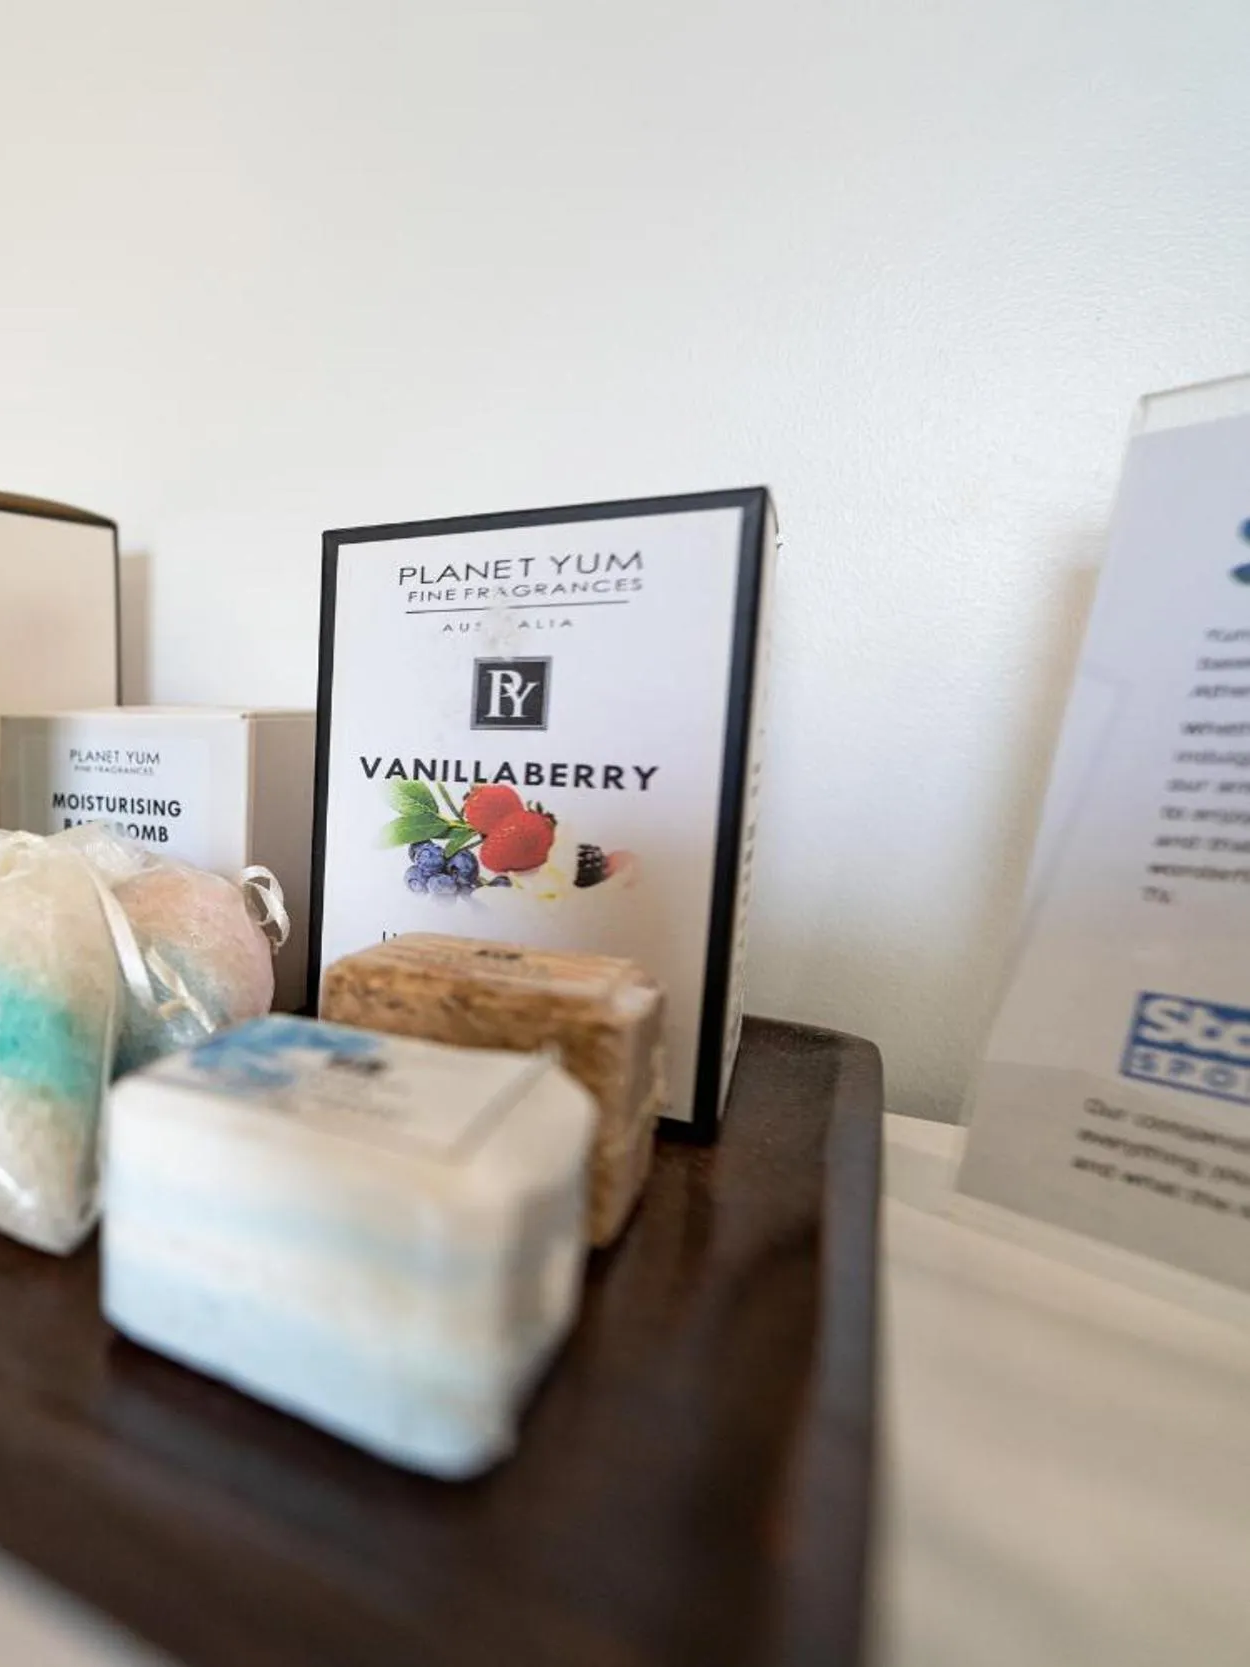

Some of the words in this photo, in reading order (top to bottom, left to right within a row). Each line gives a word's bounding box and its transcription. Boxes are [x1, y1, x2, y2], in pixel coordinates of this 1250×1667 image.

[398, 556, 537, 587] PLANET
[548, 550, 644, 575] YUM
[407, 587, 456, 603] FINE
[463, 577, 644, 602] FRAGRANCES
[69, 748, 121, 764] PLANET
[126, 750, 161, 765] YUM
[359, 755, 660, 792] VANILLABERRY
[52, 792, 182, 818] MOISTURISING
[1131, 1050, 1250, 1093] SPO
